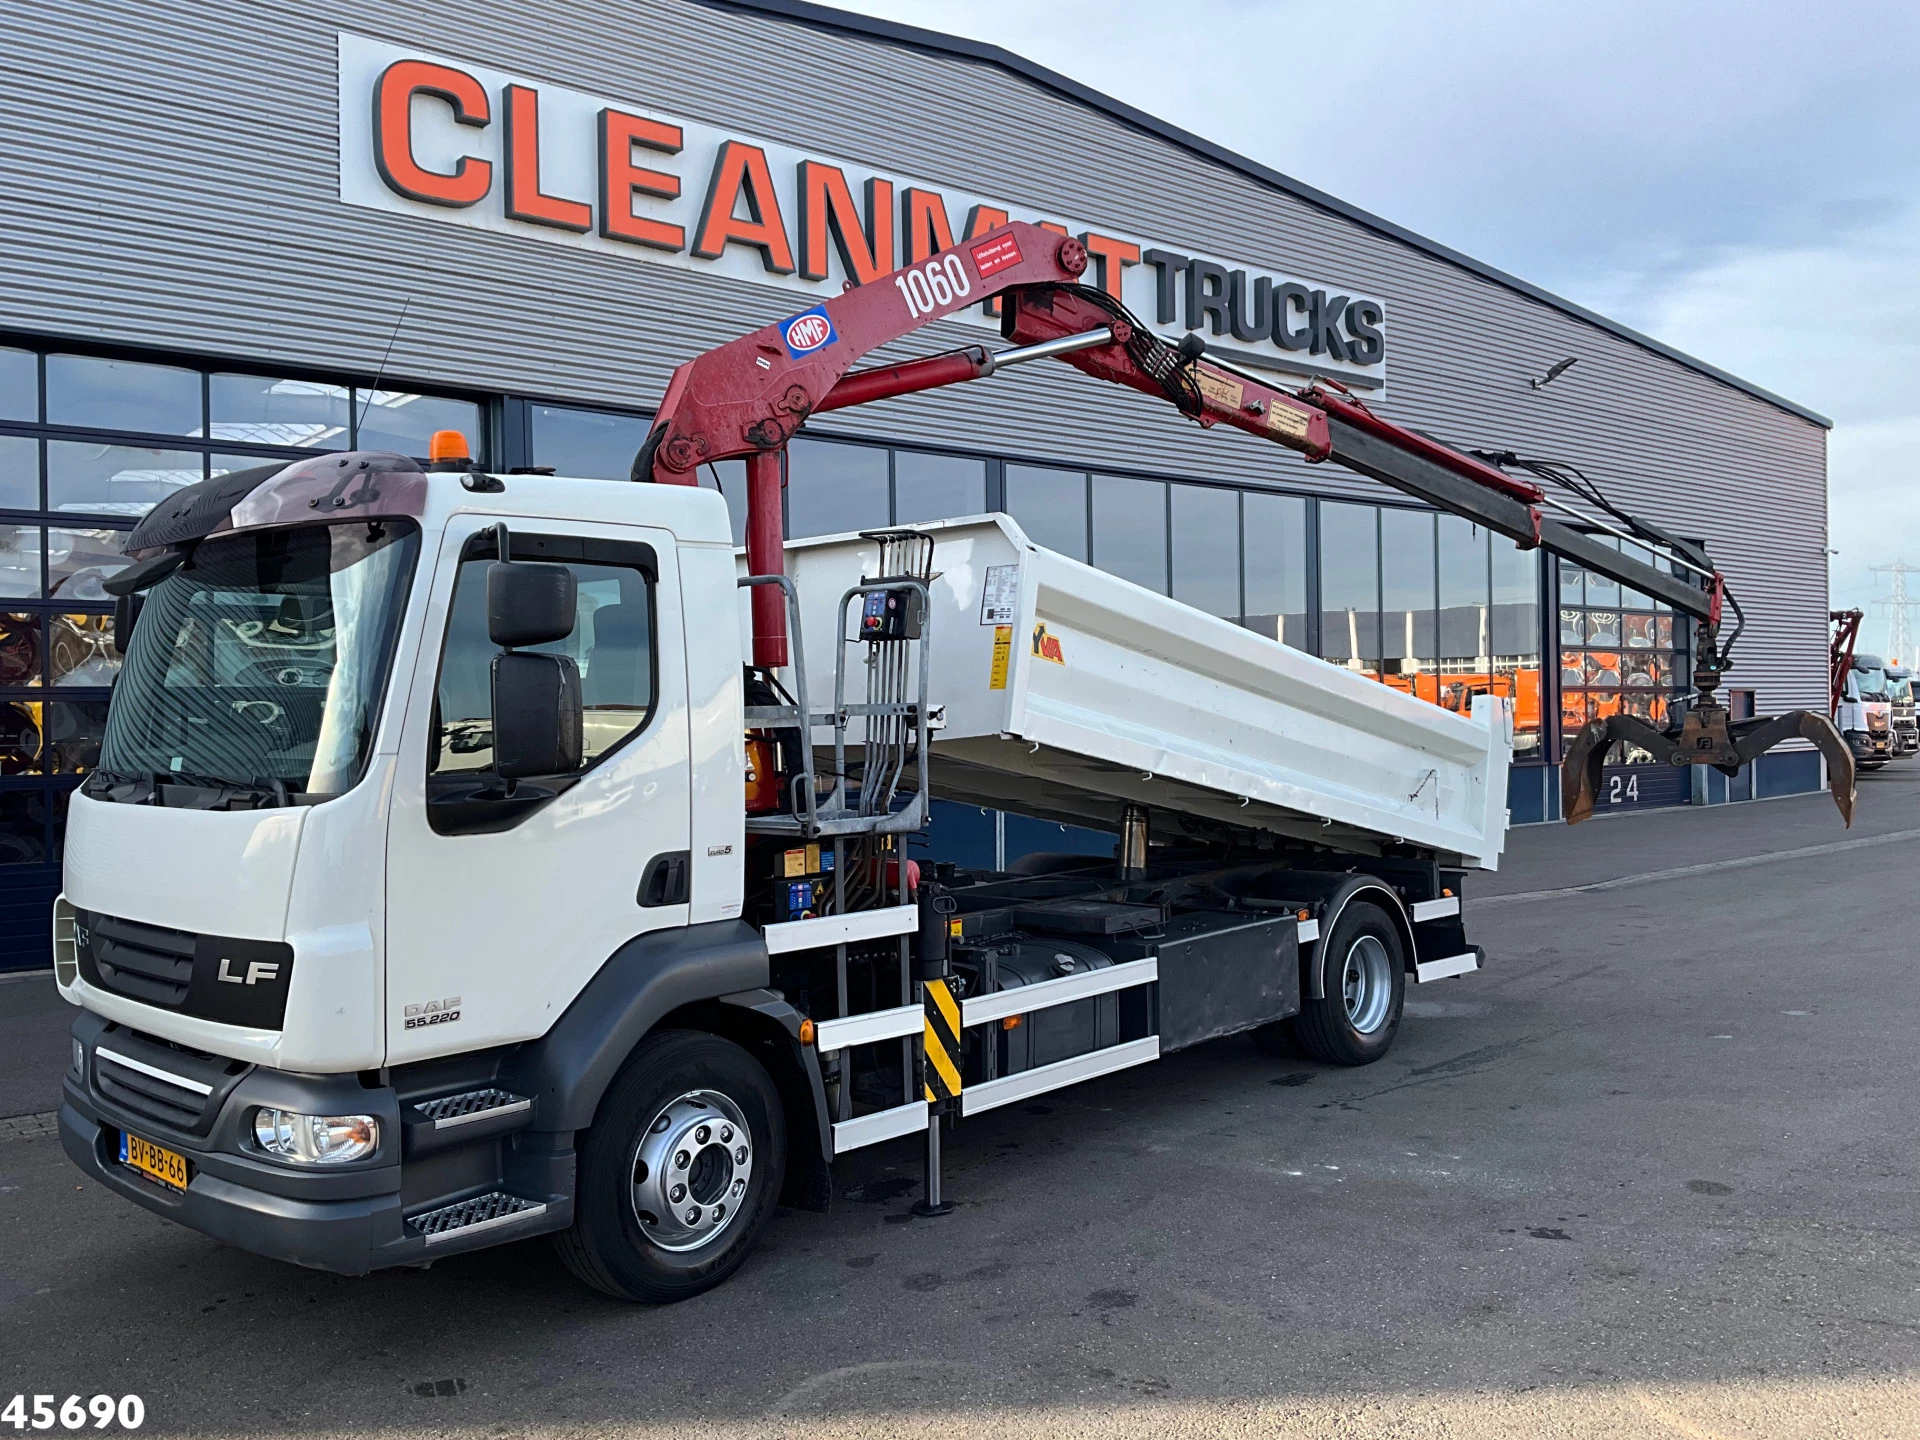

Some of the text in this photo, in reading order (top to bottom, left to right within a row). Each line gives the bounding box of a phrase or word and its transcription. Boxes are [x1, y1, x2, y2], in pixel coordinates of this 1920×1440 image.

[372, 59, 1385, 366] CLEANMT TRUCKS
[894, 254, 970, 318] 1060
[791, 318, 824, 346] HMF
[1610, 774, 1639, 803] 24
[217, 958, 280, 985] LF
[404, 996, 461, 1017] DAF
[406, 1011, 461, 1029] 55.220
[130, 1136, 184, 1182] BV-BB-66
